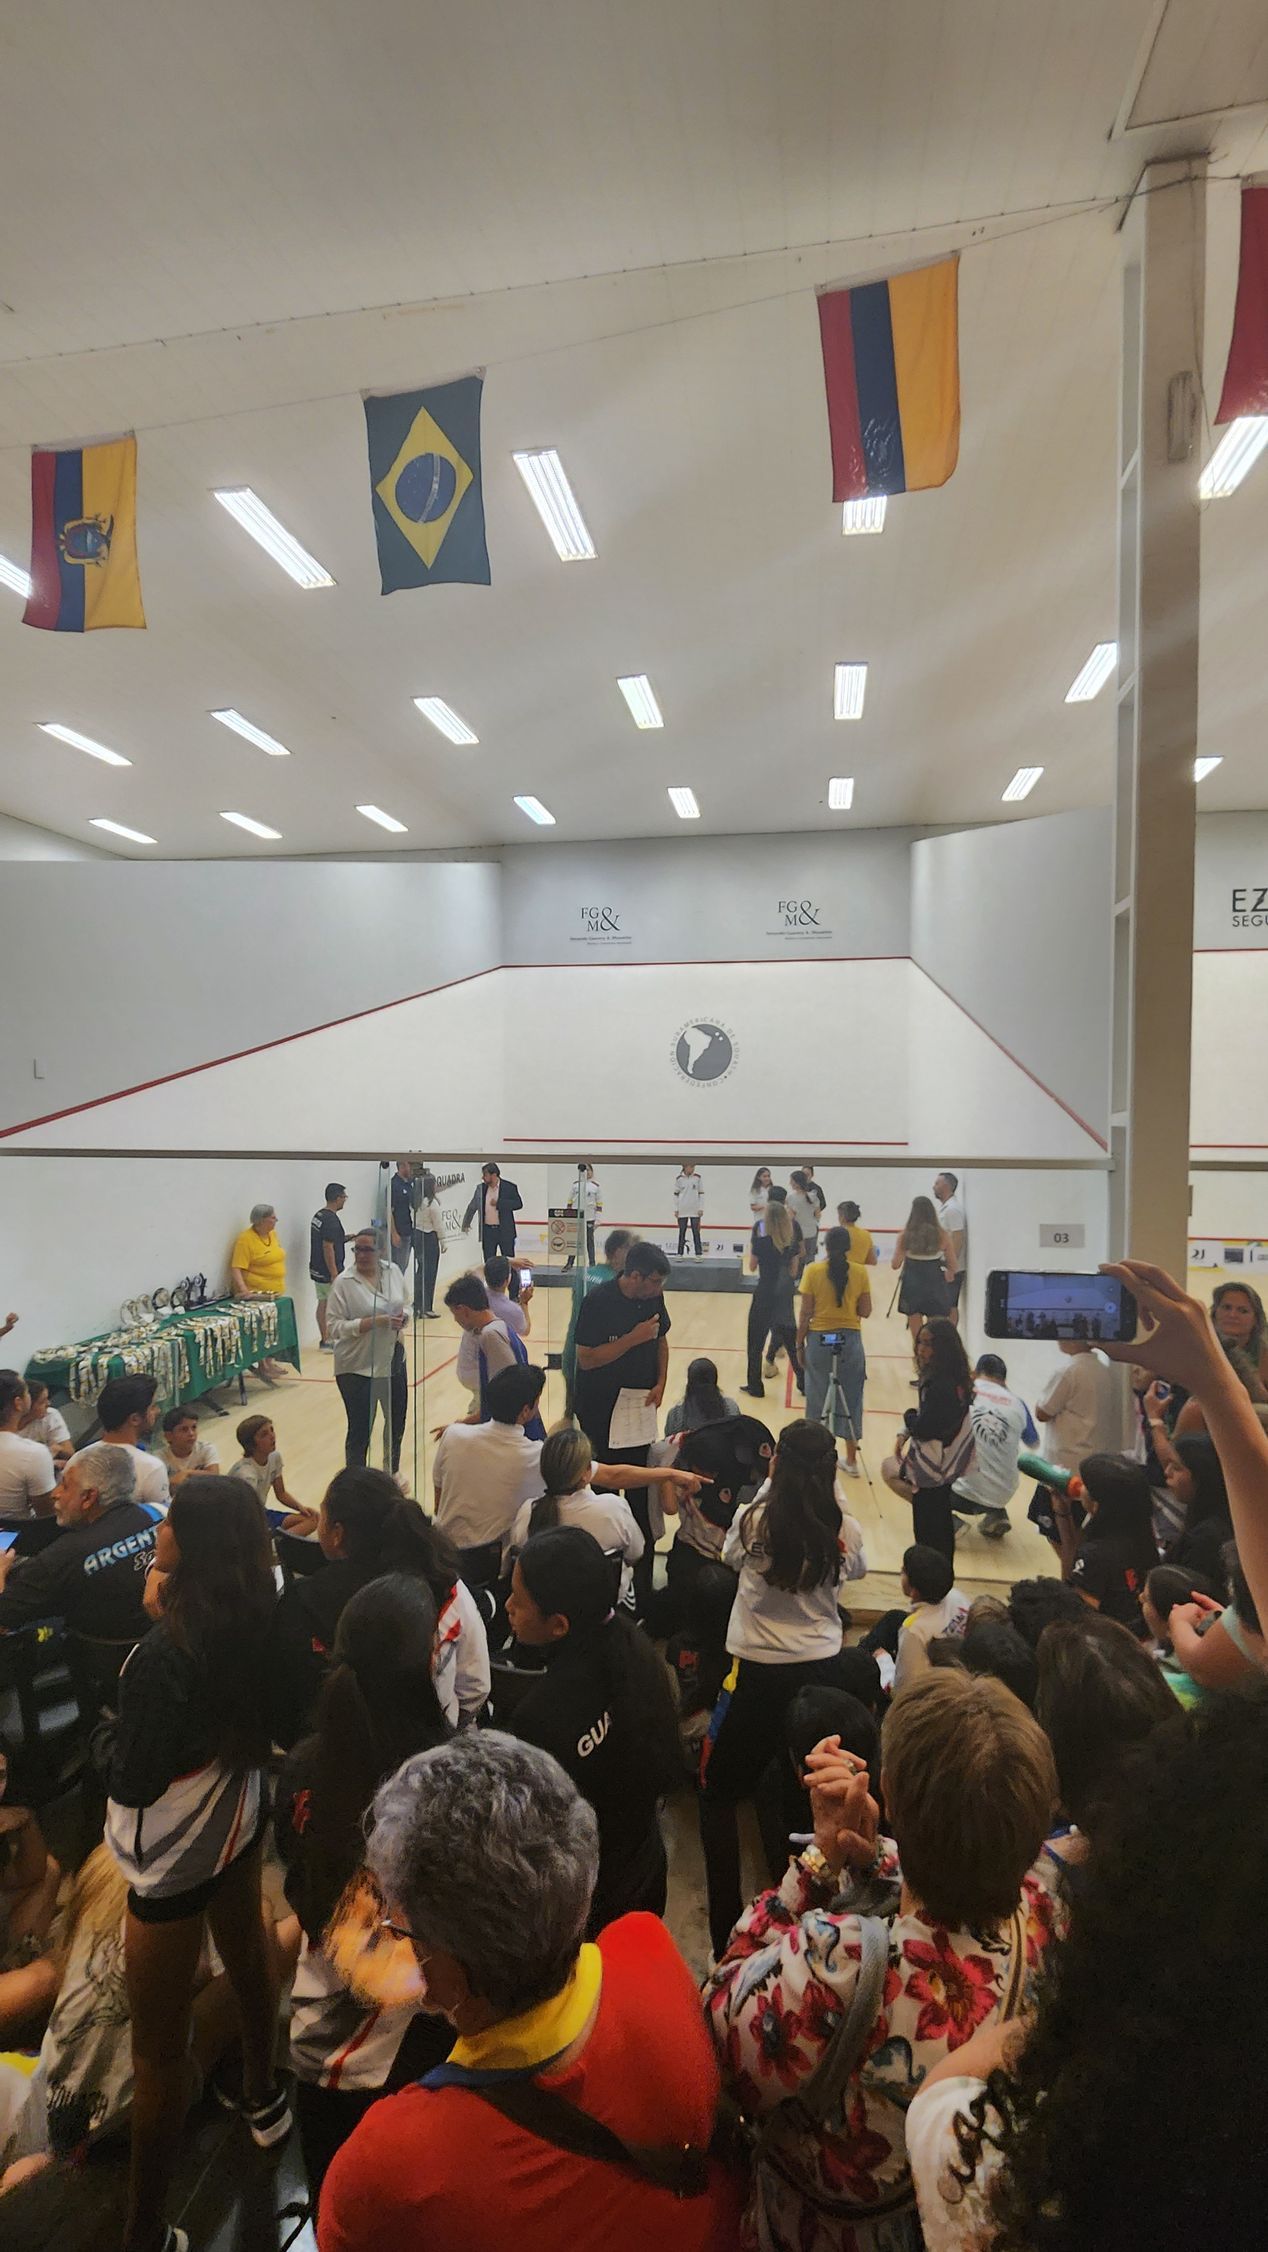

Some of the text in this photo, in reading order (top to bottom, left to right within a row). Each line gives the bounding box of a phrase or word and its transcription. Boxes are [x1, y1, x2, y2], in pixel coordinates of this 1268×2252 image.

[581, 906, 599, 919] FG
[777, 900, 798, 913] FG
[436, 1173, 465, 1187] QUADRA
[1054, 1233, 1070, 1243] 03
